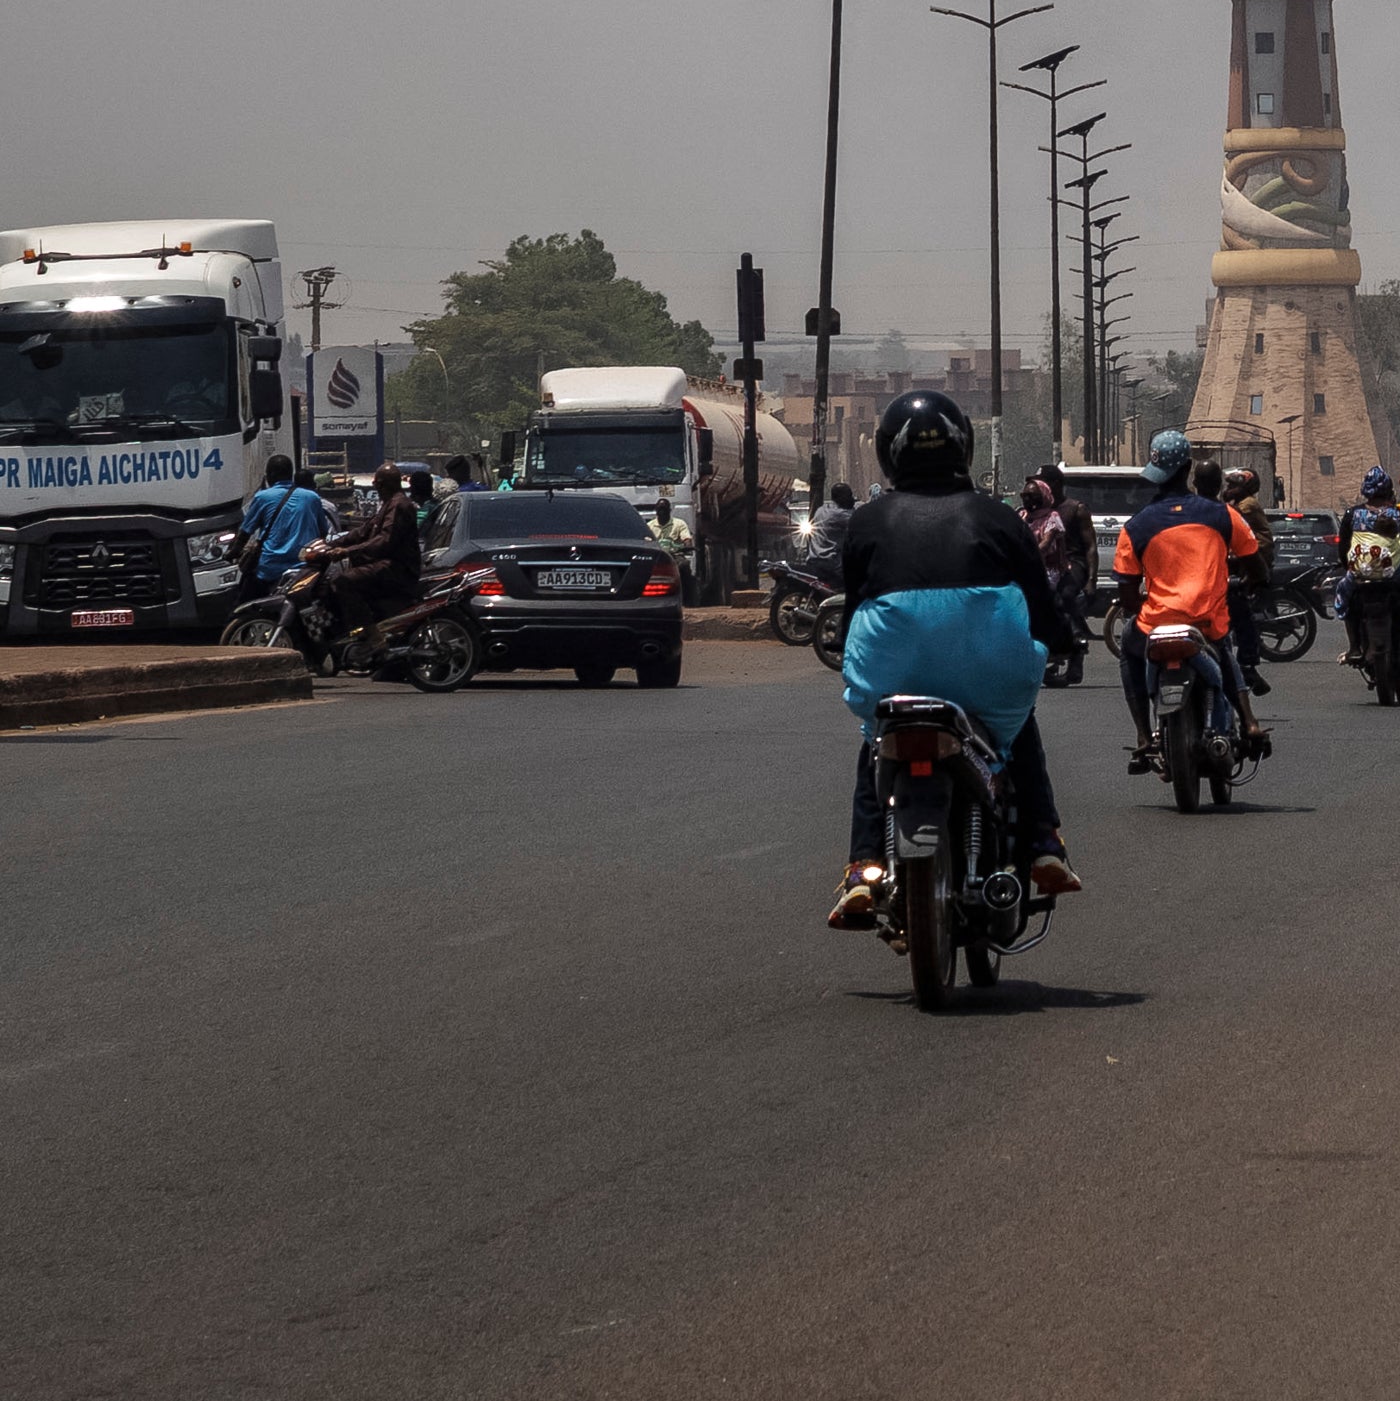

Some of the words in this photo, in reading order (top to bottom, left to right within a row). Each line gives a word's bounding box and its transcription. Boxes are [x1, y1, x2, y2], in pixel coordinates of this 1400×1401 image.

[28, 456, 93, 488] MAIGA
[98, 448, 200, 485] AICHATOU
[203, 448, 224, 471] 4
[546, 572, 603, 585] AA913CD
